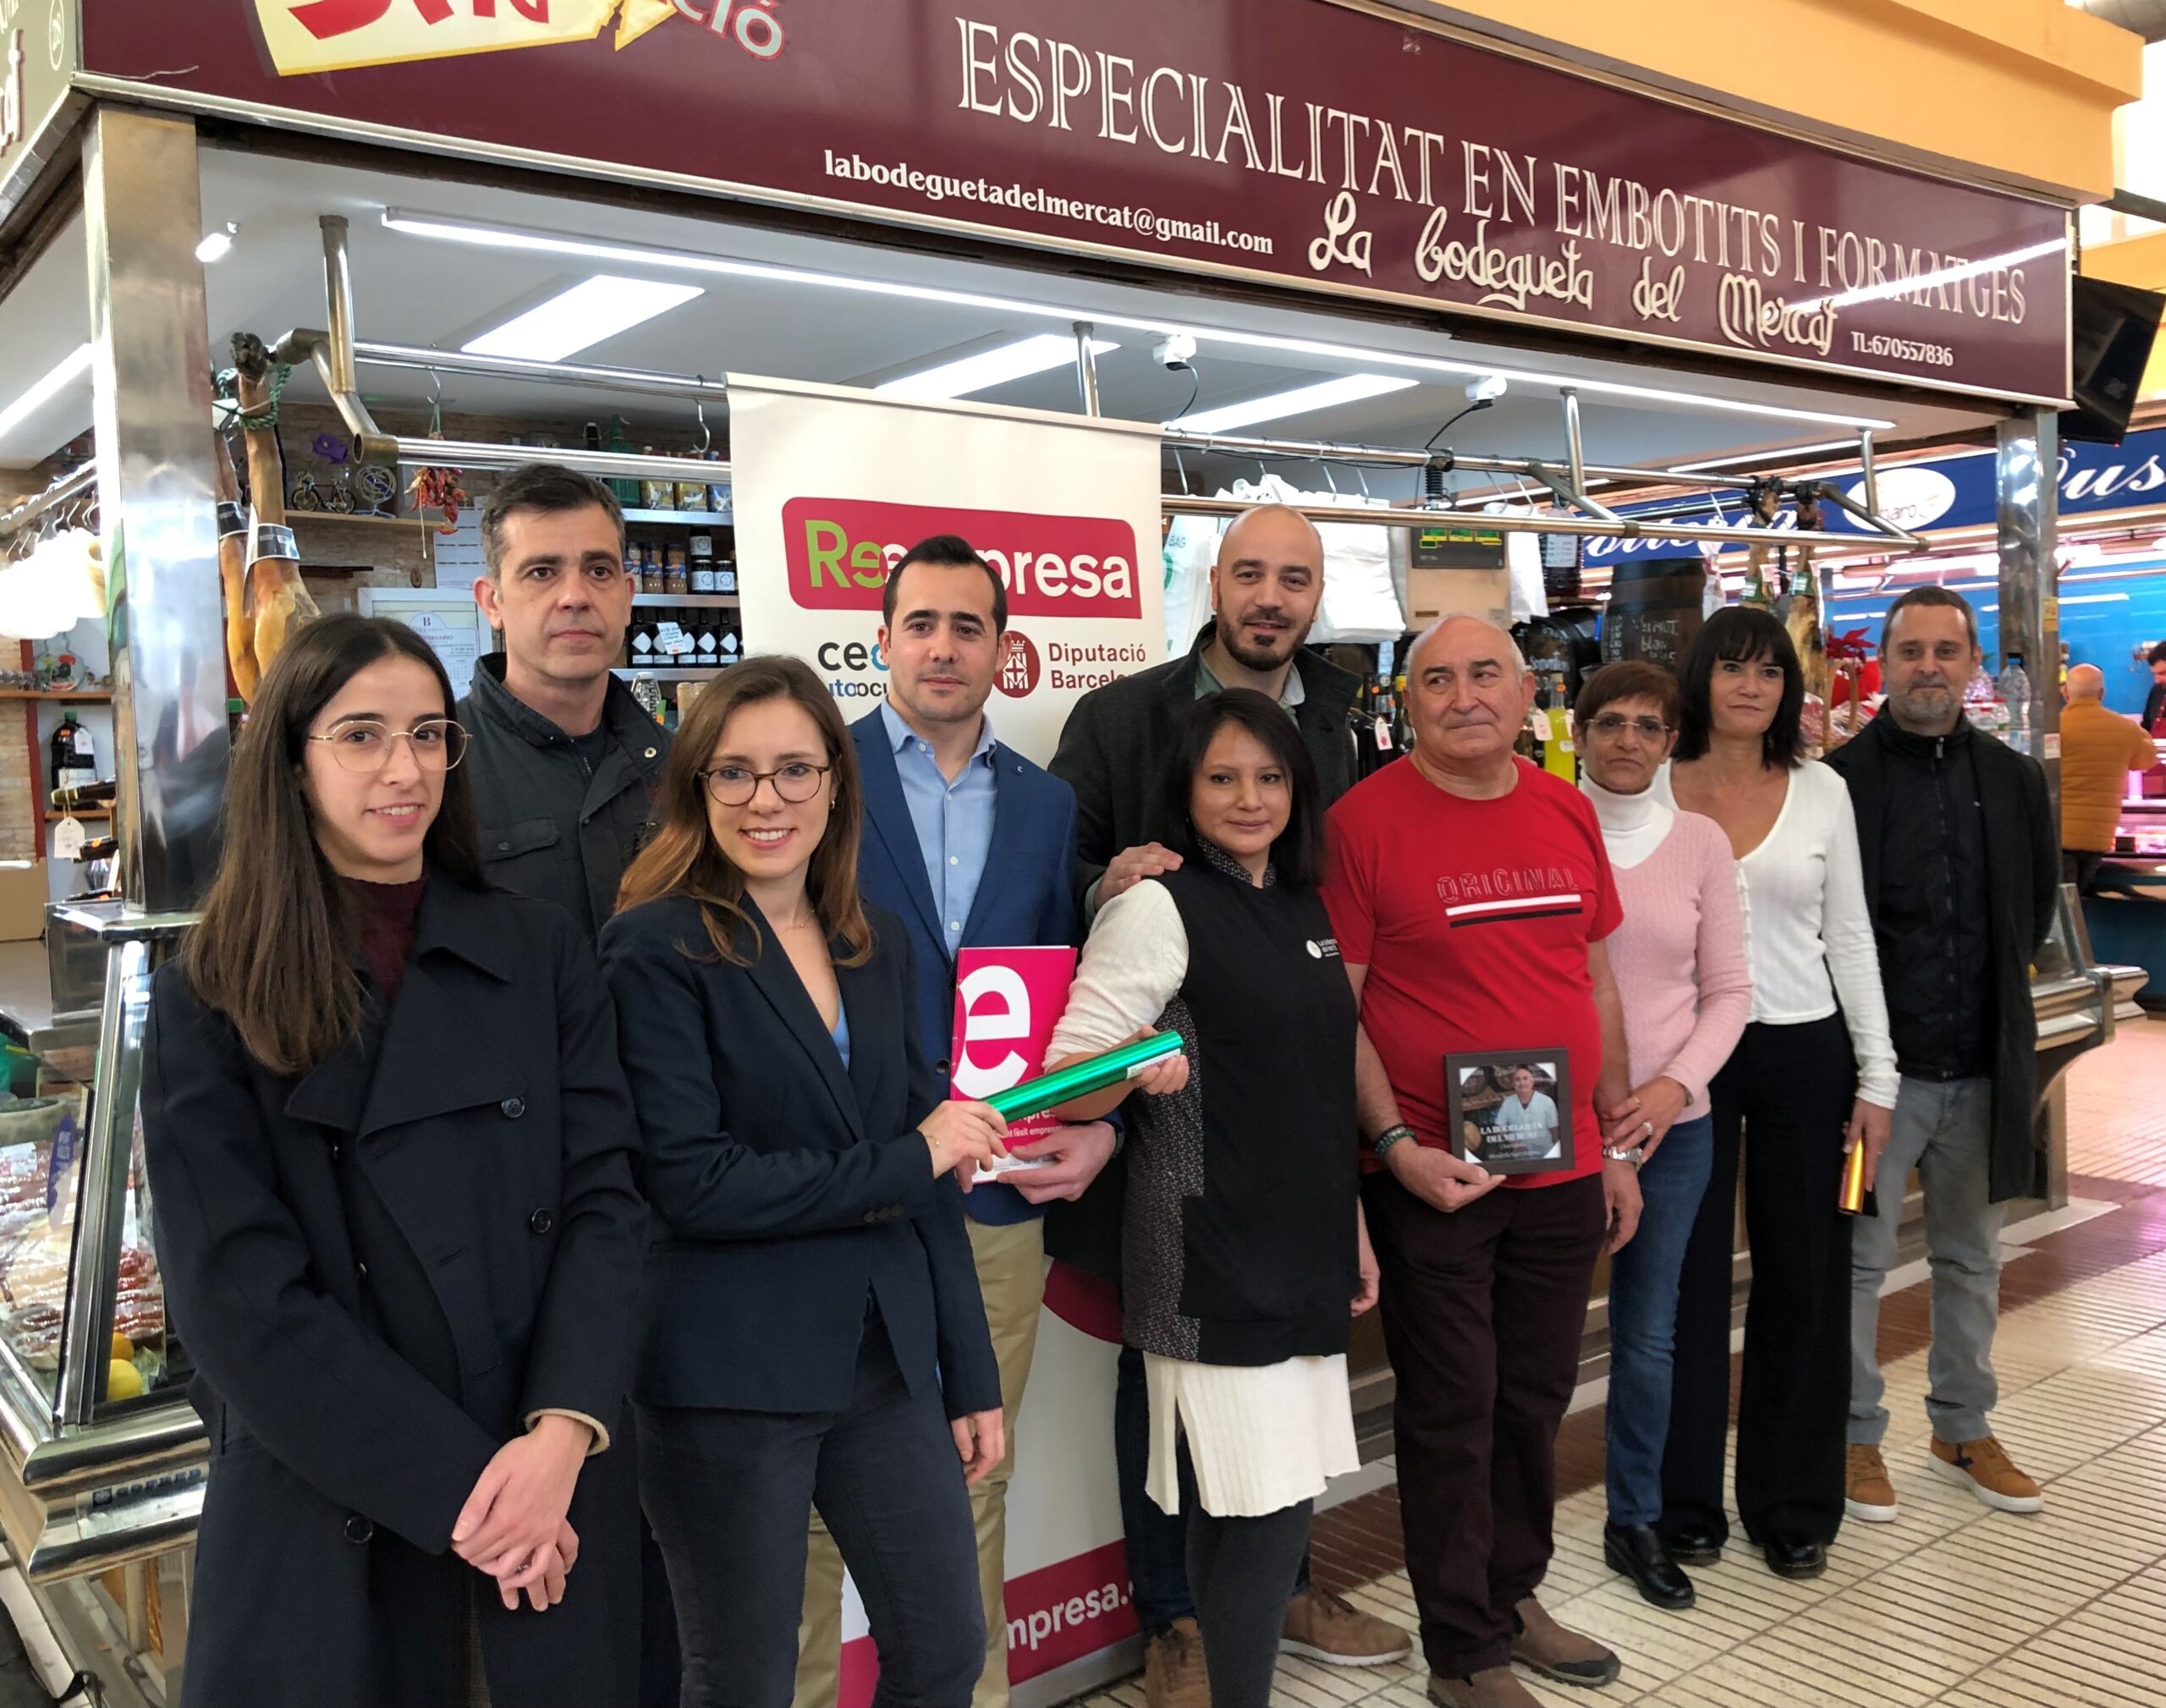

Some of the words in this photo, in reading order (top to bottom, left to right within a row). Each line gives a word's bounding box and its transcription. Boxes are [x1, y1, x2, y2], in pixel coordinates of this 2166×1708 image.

[825, 150, 1274, 254] labodeguetadelmercat@gmail.com
[954, 16, 1444, 207] ESPECIALITAT
[1460, 140, 1536, 224] EN
[1553, 162, 1780, 278] EMBOTITS
[1792, 219, 1806, 283] I
[1818, 225, 2026, 324] FORMATGES
[1308, 190, 1372, 278] La
[1634, 255, 1685, 322] del
[1851, 331, 1954, 367] TL:670557836
[1048, 642, 1146, 666] Diputació
[1438, 867, 1579, 903] ORIGINAL
